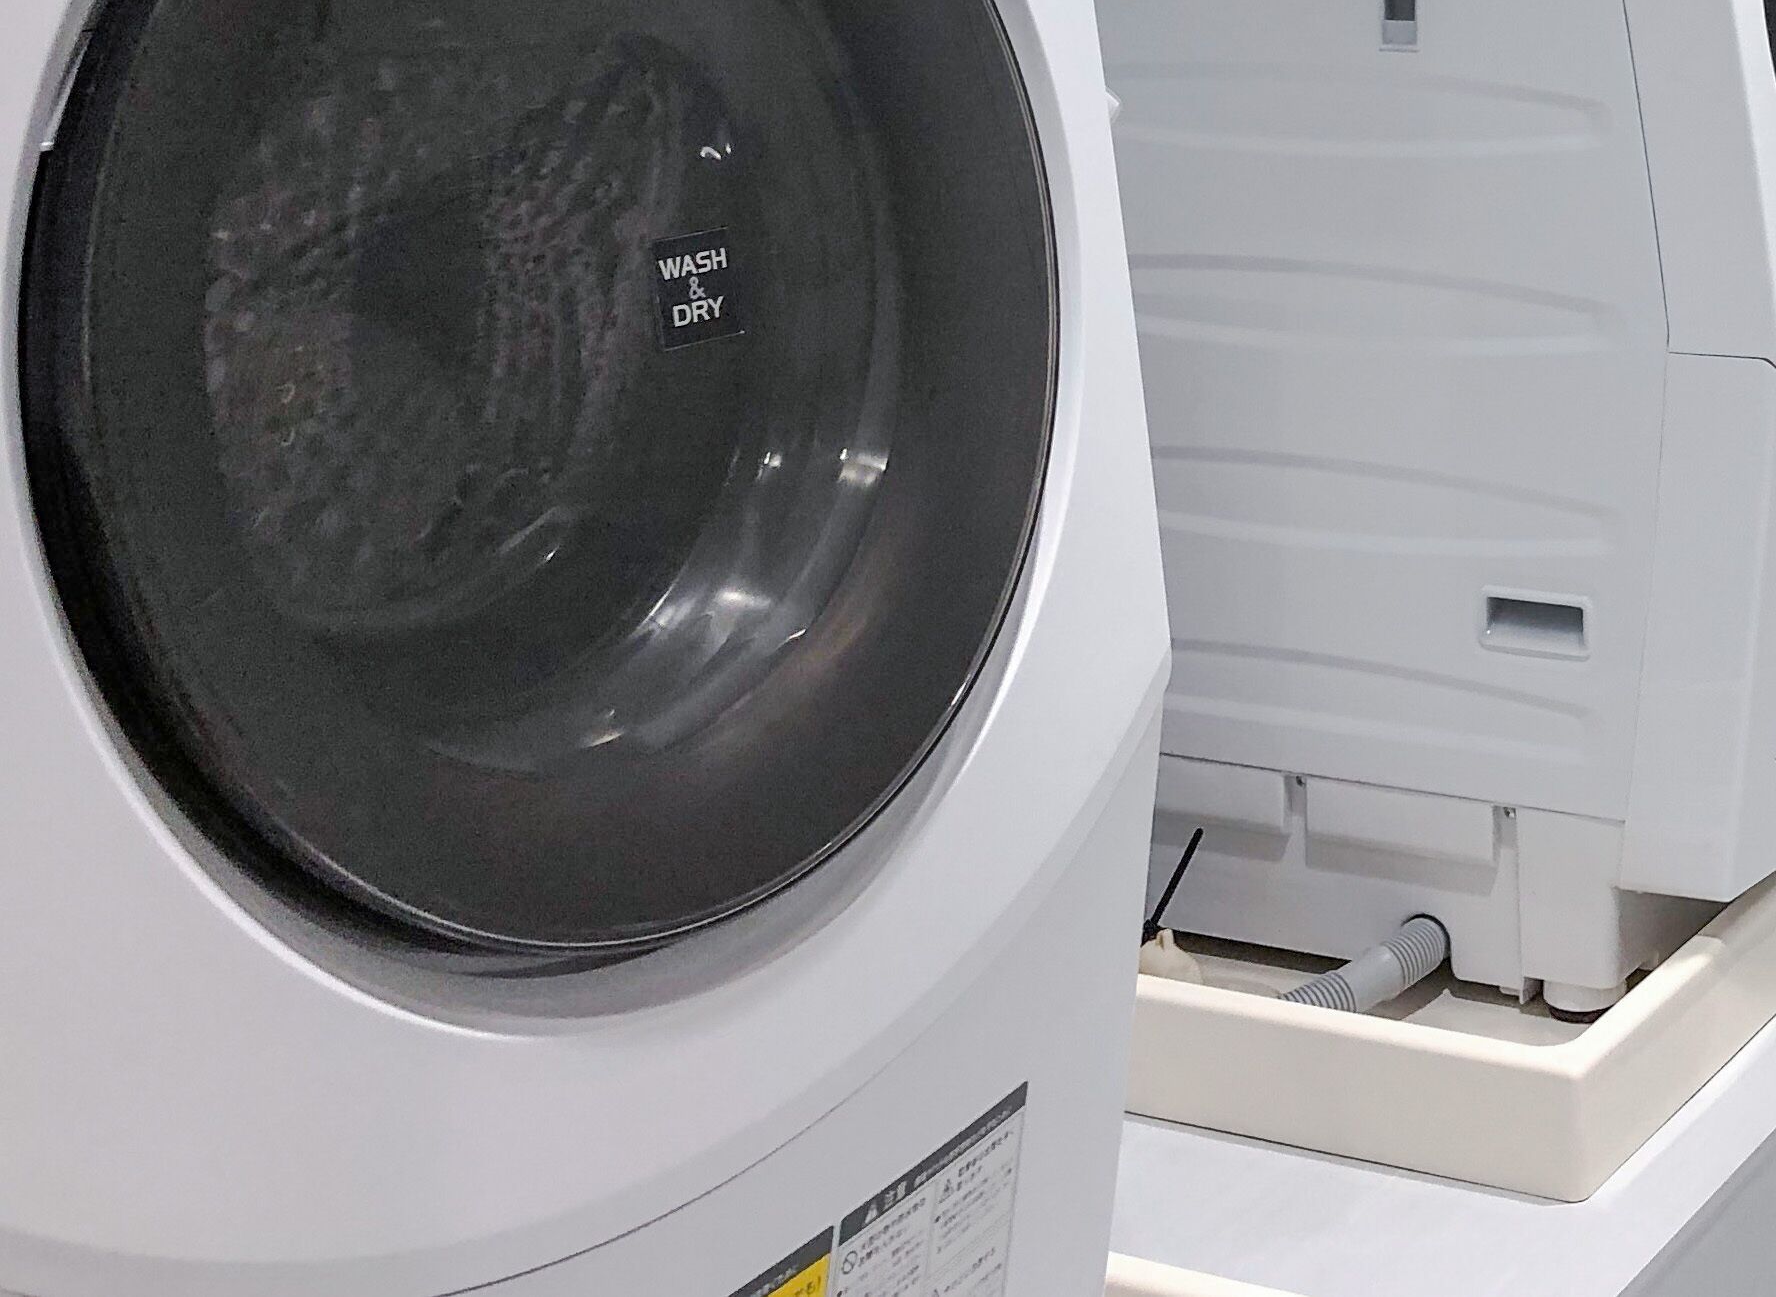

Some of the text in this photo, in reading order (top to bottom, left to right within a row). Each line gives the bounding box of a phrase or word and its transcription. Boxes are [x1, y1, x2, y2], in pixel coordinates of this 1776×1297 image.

[658, 247, 728, 281] WASH
[688, 276, 706, 301] &
[672, 295, 724, 328] DRY
